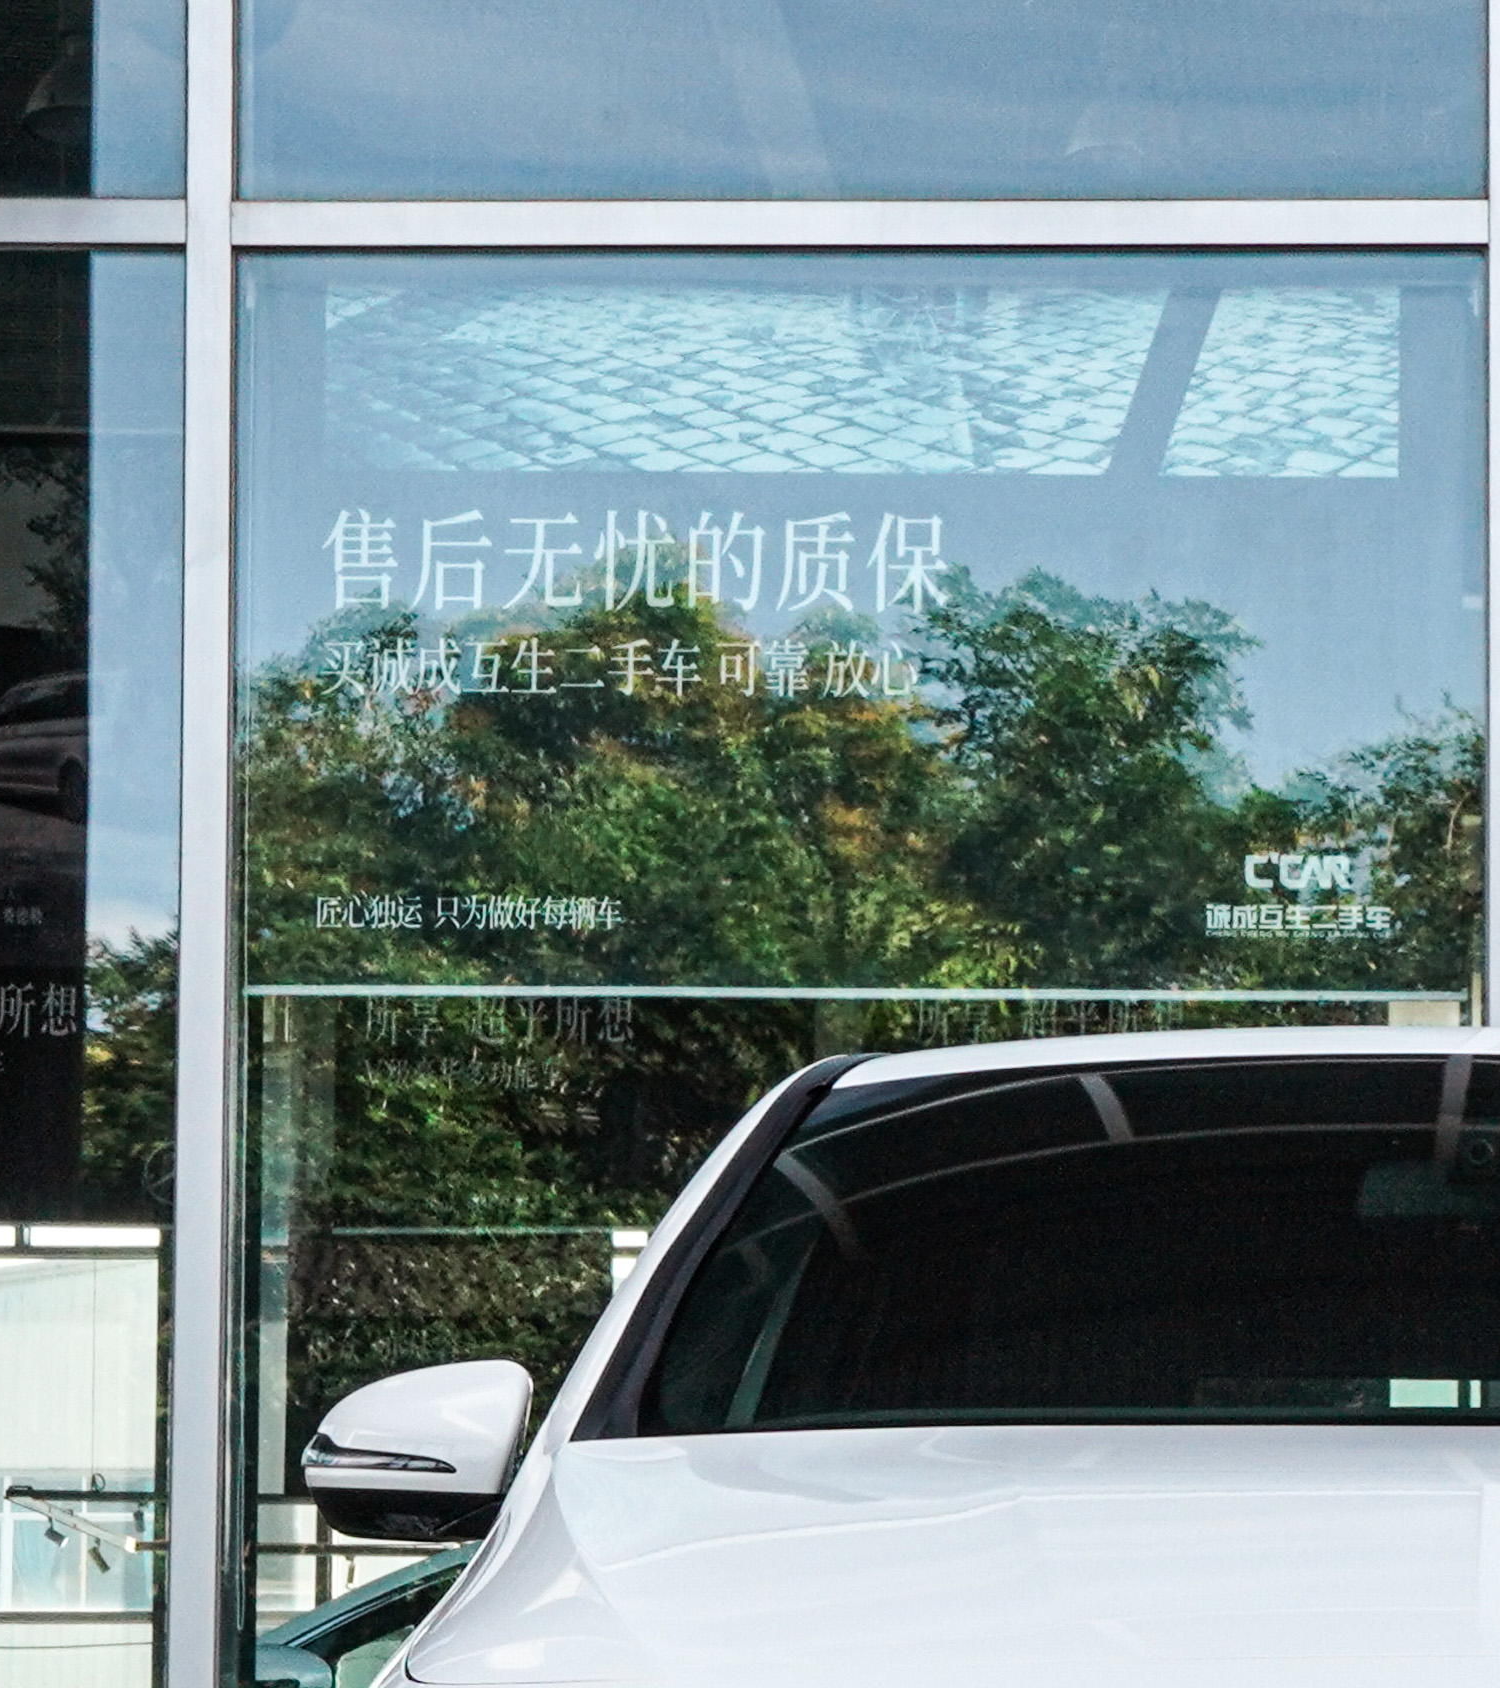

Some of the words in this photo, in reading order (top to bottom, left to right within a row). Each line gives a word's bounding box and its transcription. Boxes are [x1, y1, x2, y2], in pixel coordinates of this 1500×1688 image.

[322, 508, 949, 613] 售后无忧的质保
[320, 637, 701, 697] 买诚成互生二手车
[717, 641, 809, 698] 可靠
[823, 640, 920, 698] 放心
[316, 890, 423, 930] 匠心独运
[434, 894, 623, 931] 只为做好每辆车
[1206, 904, 1393, 930] 诚成互生二手车
